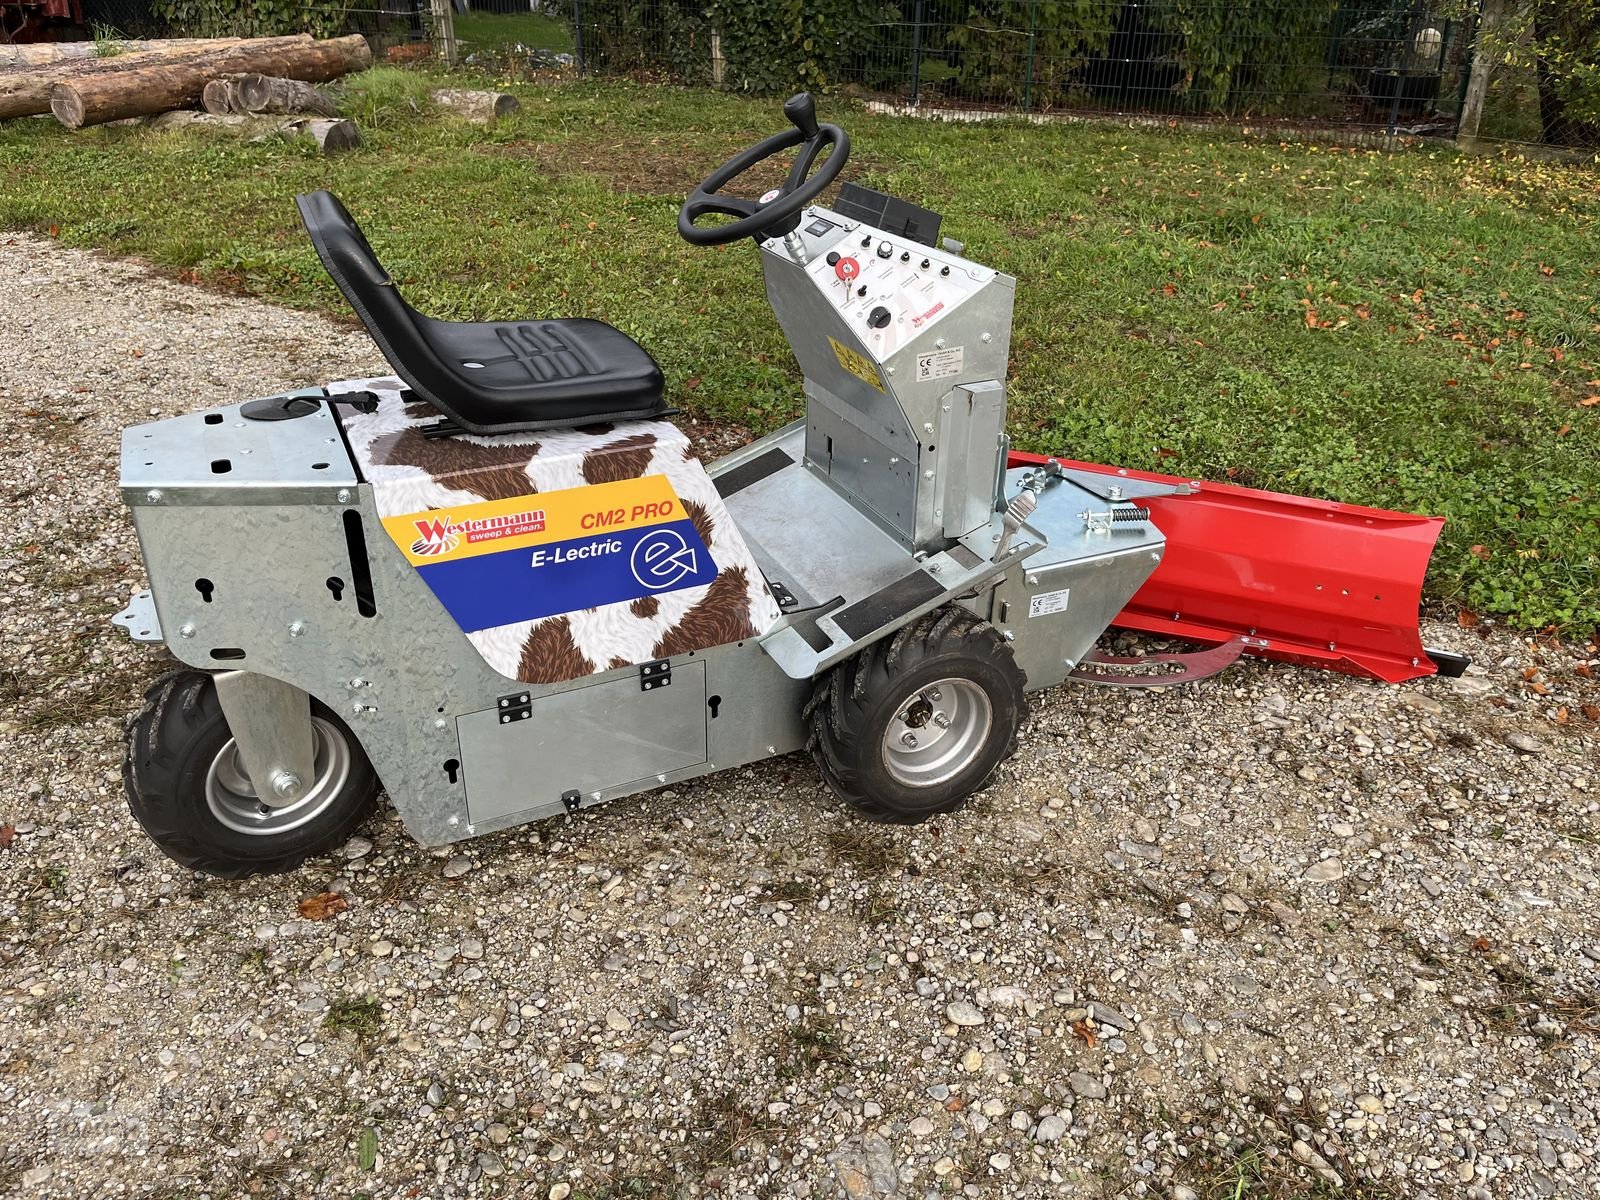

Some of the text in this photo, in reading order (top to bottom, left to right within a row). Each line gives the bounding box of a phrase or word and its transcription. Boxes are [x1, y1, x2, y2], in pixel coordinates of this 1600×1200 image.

[415, 510, 545, 543] Westermann
[580, 500, 673, 529] CM2 PRO
[470, 523, 543, 541] sweep & clean.
[531, 538, 622, 568] E-Lectric
